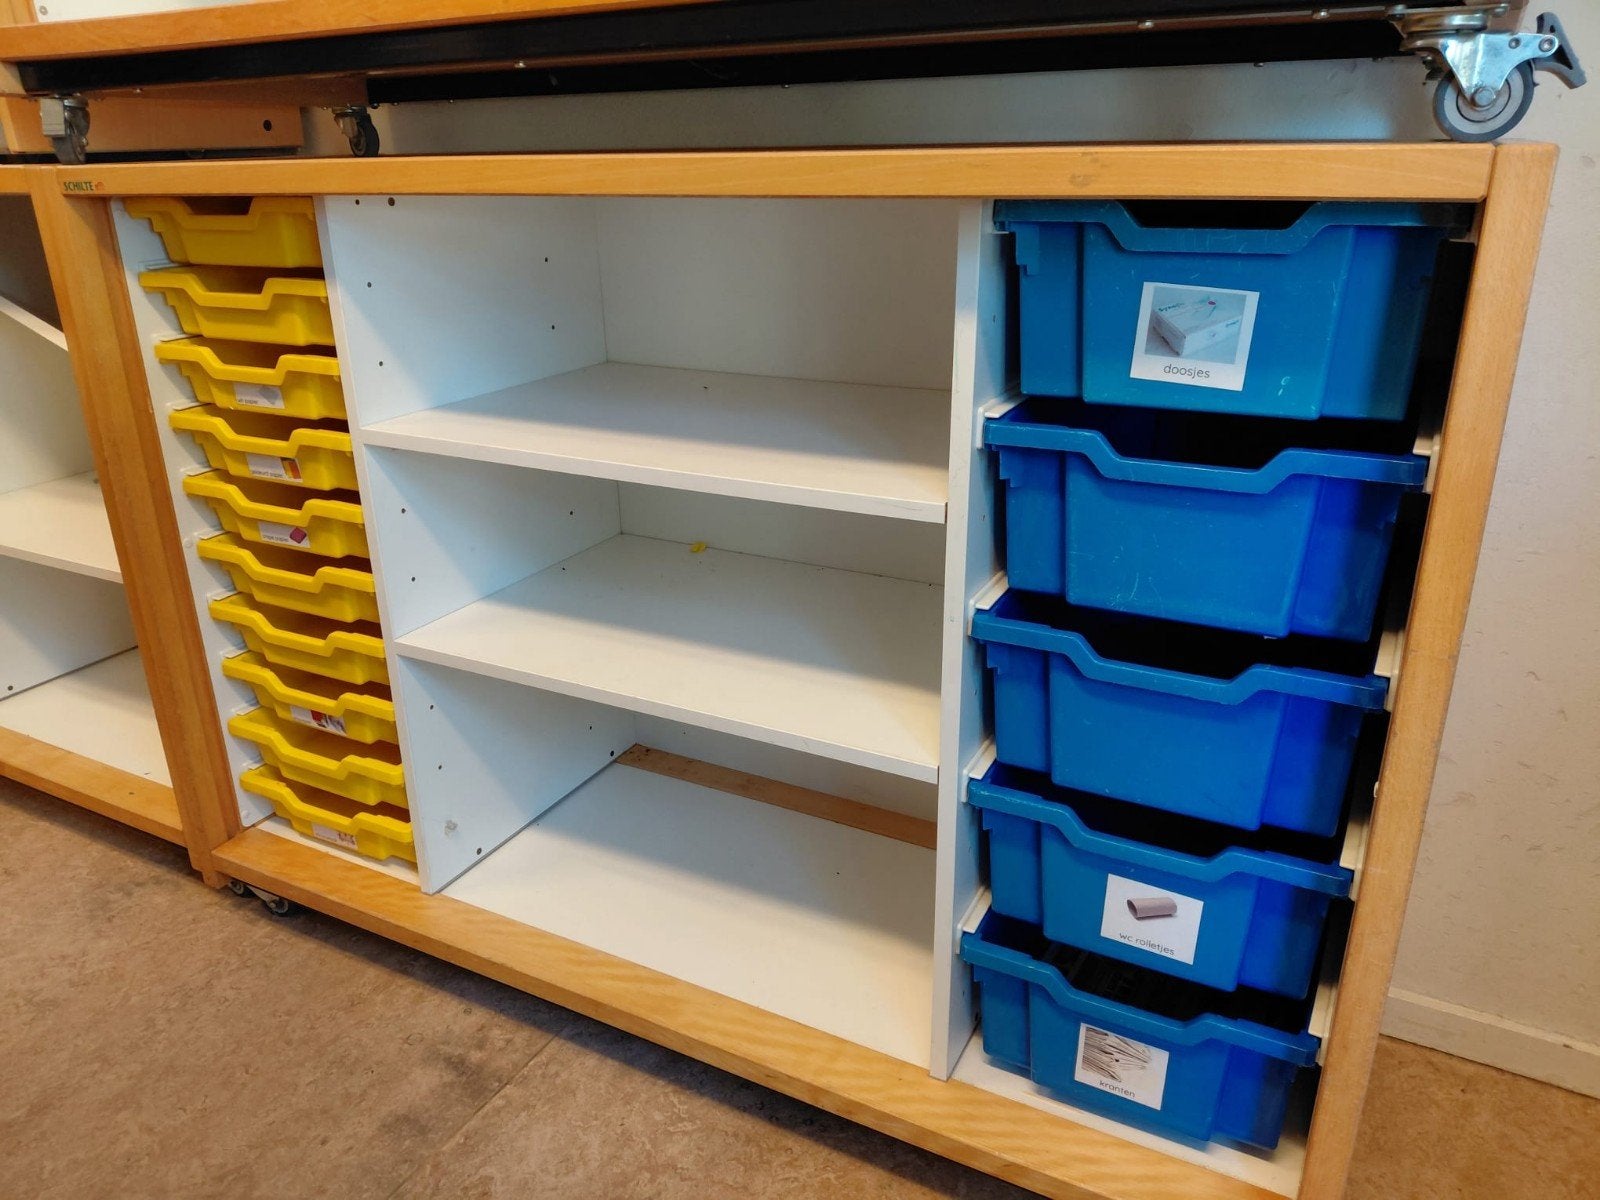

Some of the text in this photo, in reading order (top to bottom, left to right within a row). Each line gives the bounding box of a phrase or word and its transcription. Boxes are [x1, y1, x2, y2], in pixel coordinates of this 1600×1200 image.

[63, 181, 94, 191] SCHILTE
[1163, 363, 1211, 379] doosjes
[1119, 932, 1176, 956] wc rolletjes
[1099, 1080, 1136, 1098] kranten
